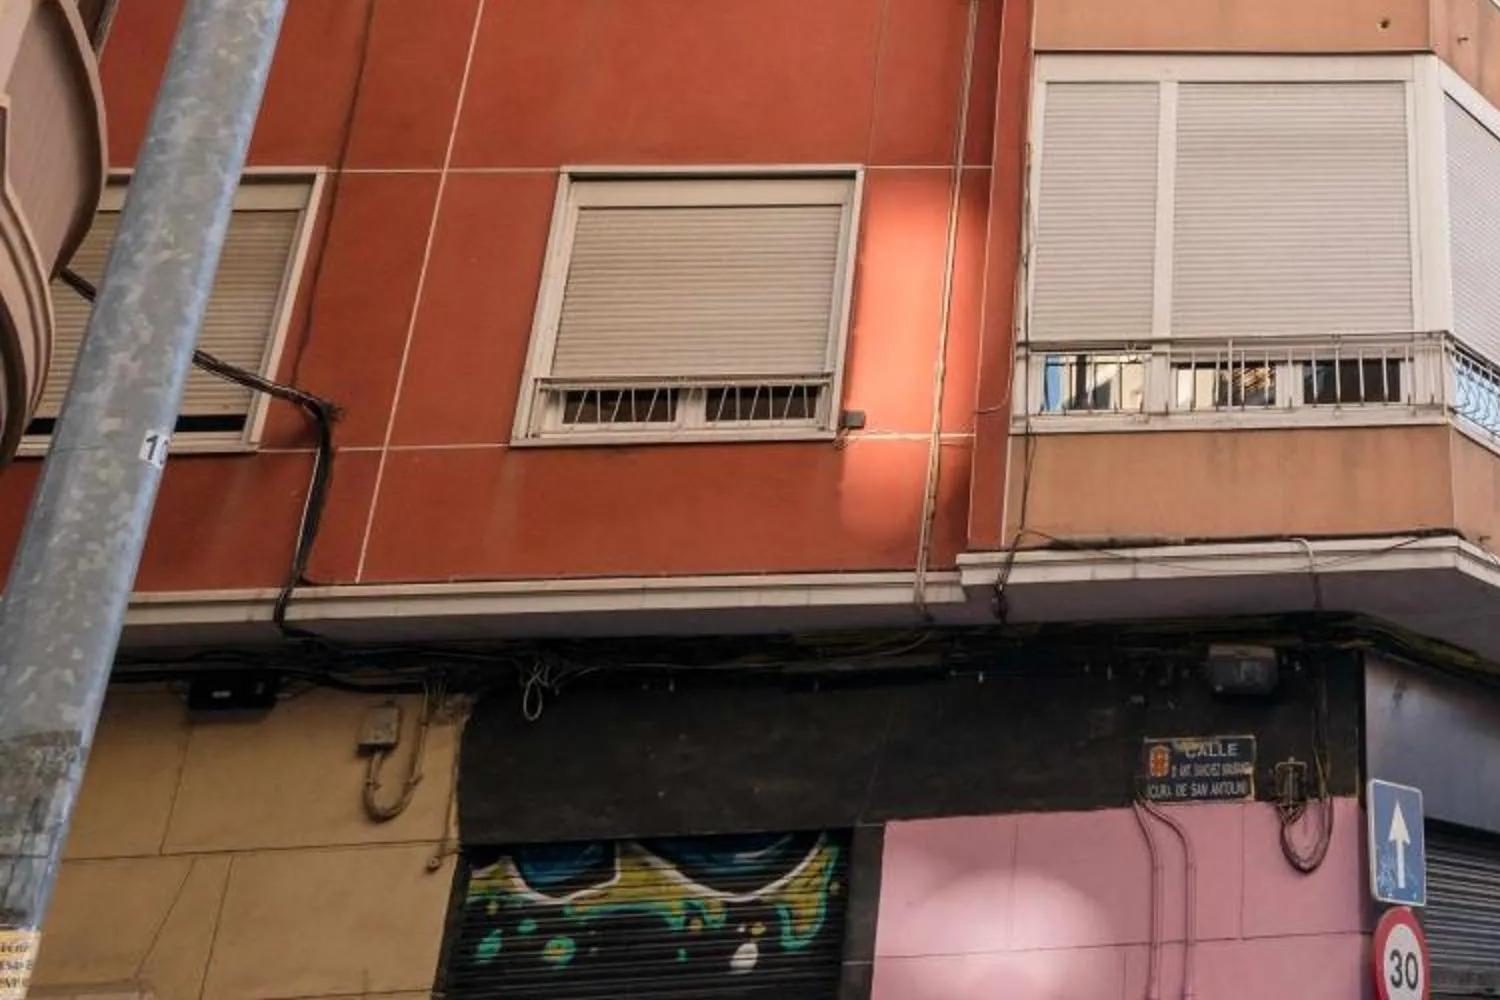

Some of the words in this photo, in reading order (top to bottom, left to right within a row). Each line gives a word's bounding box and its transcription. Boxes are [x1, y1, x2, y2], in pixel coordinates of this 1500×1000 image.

[1185, 742, 1239, 759] CALLE
[1175, 783, 1187, 797] DE
[1191, 782, 1208, 797] SAN
[1390, 949, 1419, 990] 30
